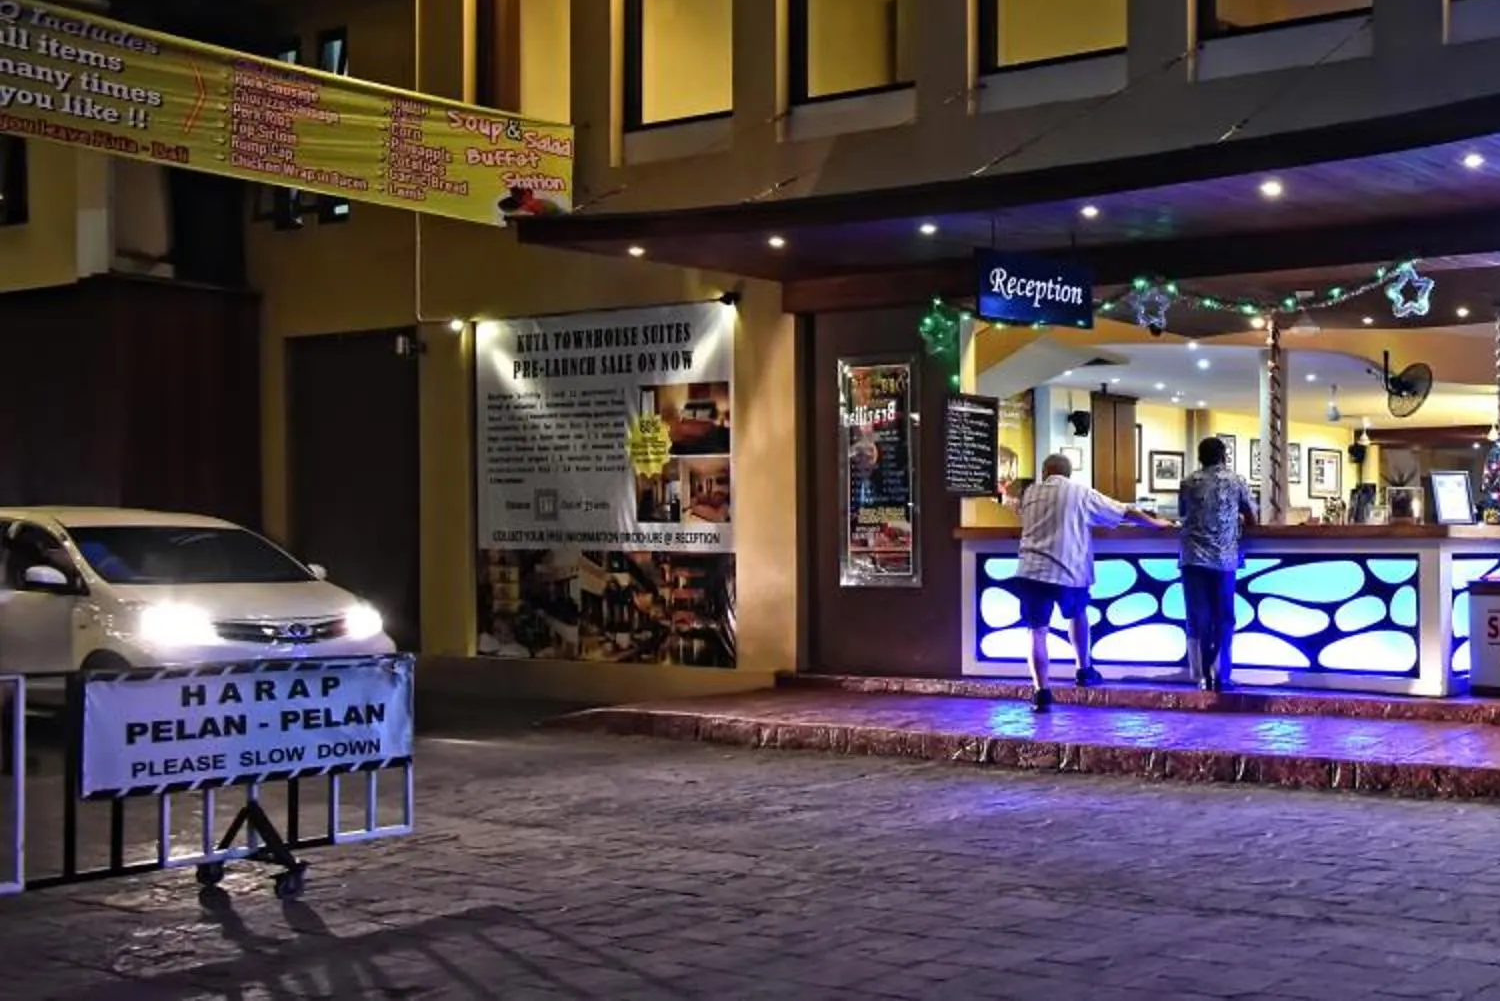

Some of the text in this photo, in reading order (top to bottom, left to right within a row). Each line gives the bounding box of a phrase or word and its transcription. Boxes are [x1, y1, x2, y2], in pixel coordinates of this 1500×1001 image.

[31, 8, 159, 54] Includes
[38, 34, 123, 71] items
[0, 85, 53, 109] you
[61, 94, 120, 122] like
[81, 72, 162, 106] times
[391, 122, 422, 141] Corn
[447, 111, 504, 143] Soup
[505, 118, 521, 141] &
[523, 131, 572, 157] Salad
[231, 152, 280, 173] Chicken
[283, 163, 315, 182] Wrap
[502, 172, 565, 191] Station
[990, 267, 1083, 308] Reception
[517, 322, 691, 353] KUTA TOWNHOUSE SUITES
[513, 350, 693, 379] PRE-LAUNCH SALE ON NOW
[126, 714, 247, 745] PELAN
[280, 703, 385, 732] PELAN
[131, 739, 381, 778] PLEASE SLOW DOWN
